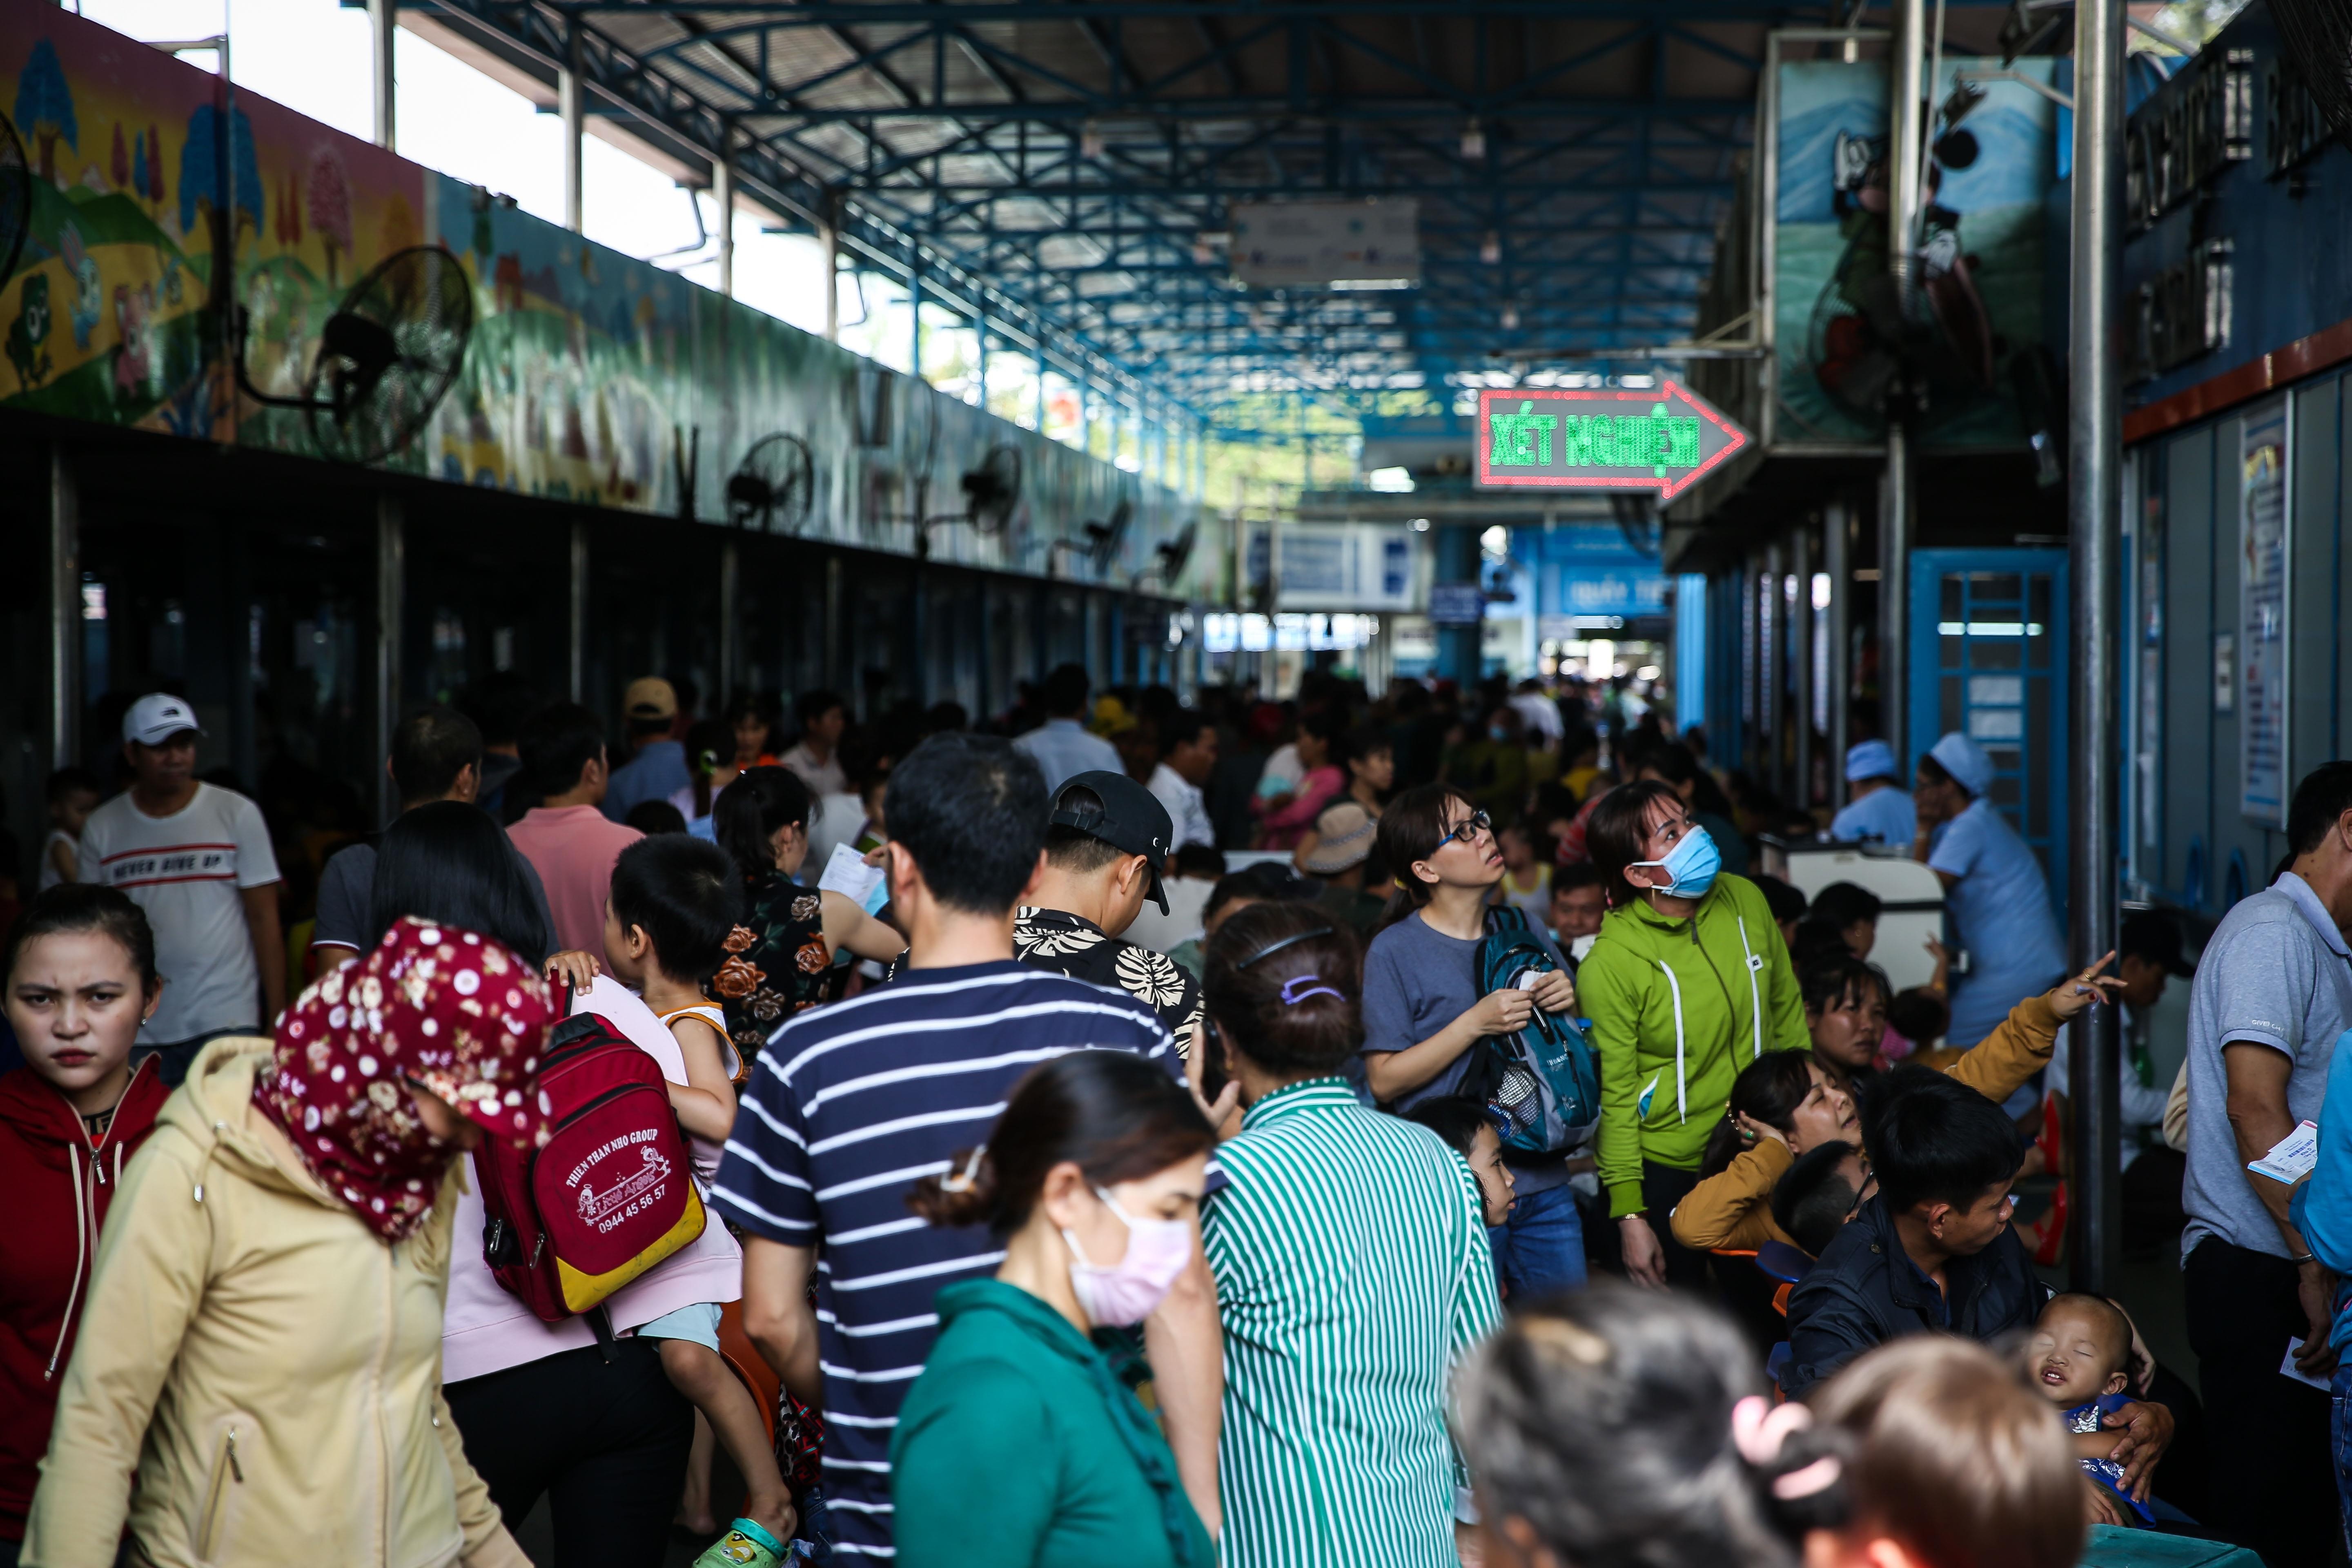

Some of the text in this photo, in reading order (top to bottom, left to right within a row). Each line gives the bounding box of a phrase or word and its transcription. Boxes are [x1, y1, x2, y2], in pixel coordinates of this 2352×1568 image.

[1490, 400, 1700, 478] XÉT NGHIỆM
[114, 859, 155, 878] NEVER
[202, 854, 221, 869] UP
[566, 1129, 657, 1188] THIEN THAN NHO GROUP
[599, 1184, 665, 1234] 0944 45 56 57
